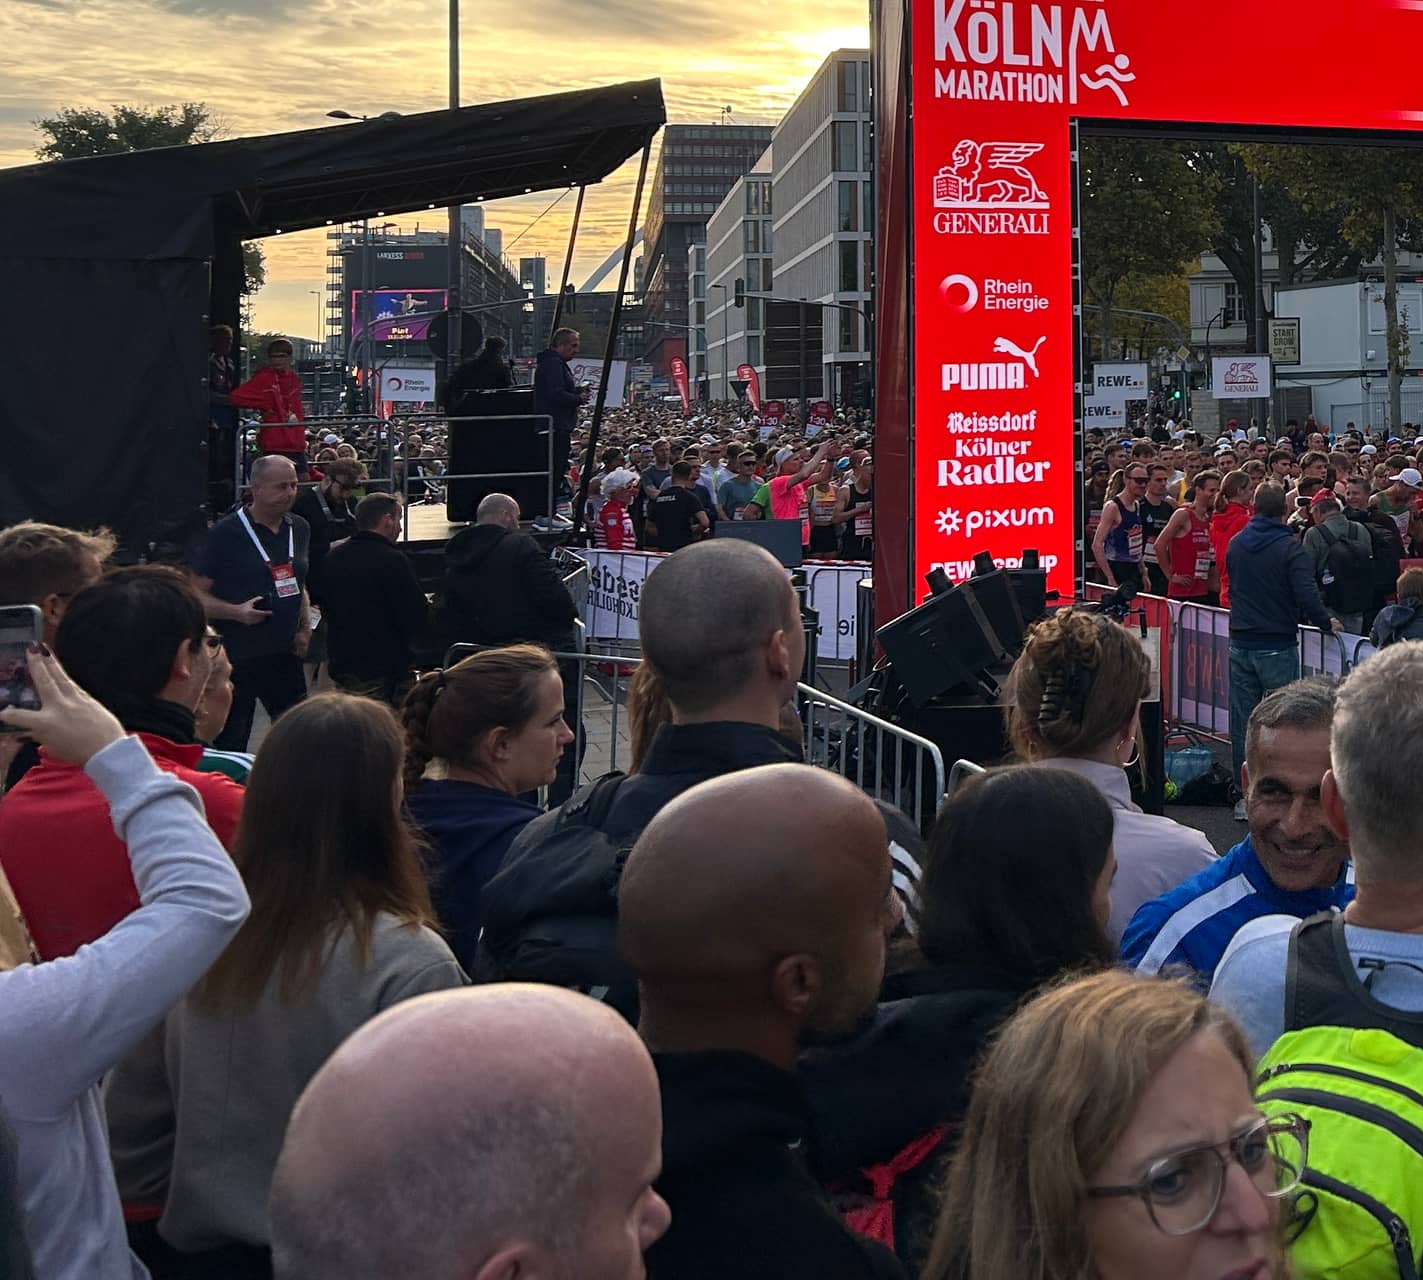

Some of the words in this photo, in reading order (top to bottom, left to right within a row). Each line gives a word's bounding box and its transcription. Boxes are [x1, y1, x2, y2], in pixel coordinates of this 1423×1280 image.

[934, 0, 1062, 67] KÖLN
[934, 68, 1063, 104] MARATHON
[933, 212, 1050, 235] GENERALI
[984, 279, 1032, 295] Rhein
[984, 294, 1050, 313] Energie
[941, 362, 1025, 391] PUMA
[1097, 375, 1132, 387] REWE
[1224, 383, 1259, 393] GENERALI
[946, 409, 1037, 435] Reissdorf
[955, 438, 1032, 457] Kölner
[937, 457, 1051, 487] Radler
[966, 506, 1054, 538] pixum
